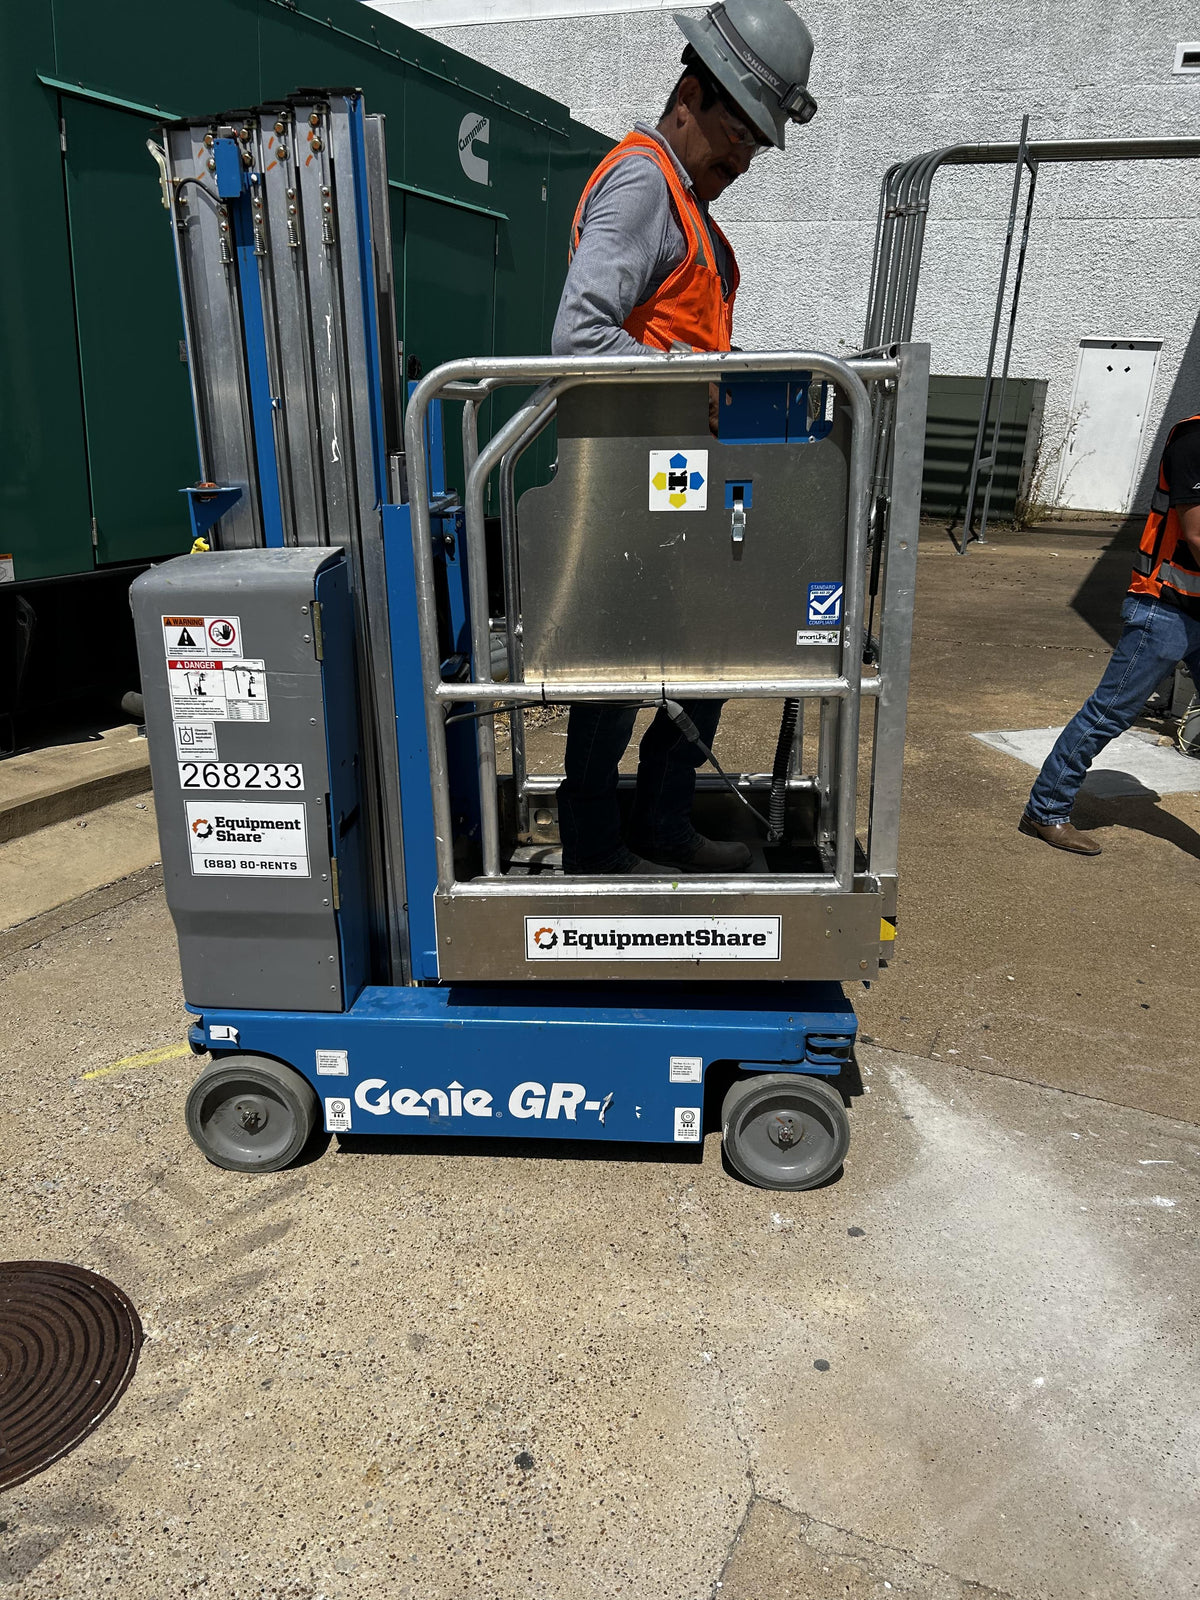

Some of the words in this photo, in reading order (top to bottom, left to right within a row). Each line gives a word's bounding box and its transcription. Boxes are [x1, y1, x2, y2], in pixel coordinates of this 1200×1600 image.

[751, 59, 780, 86] HUSKY
[459, 117, 487, 151] Cummins
[172, 618, 203, 626] WARNING
[184, 661, 216, 669] DANGER
[181, 763, 302, 788] 268233
[215, 816, 301, 831] Equipment
[204, 859, 236, 869] (888)
[240, 860, 297, 870] 80-RENTS
[354, 1078, 493, 1118] Genie
